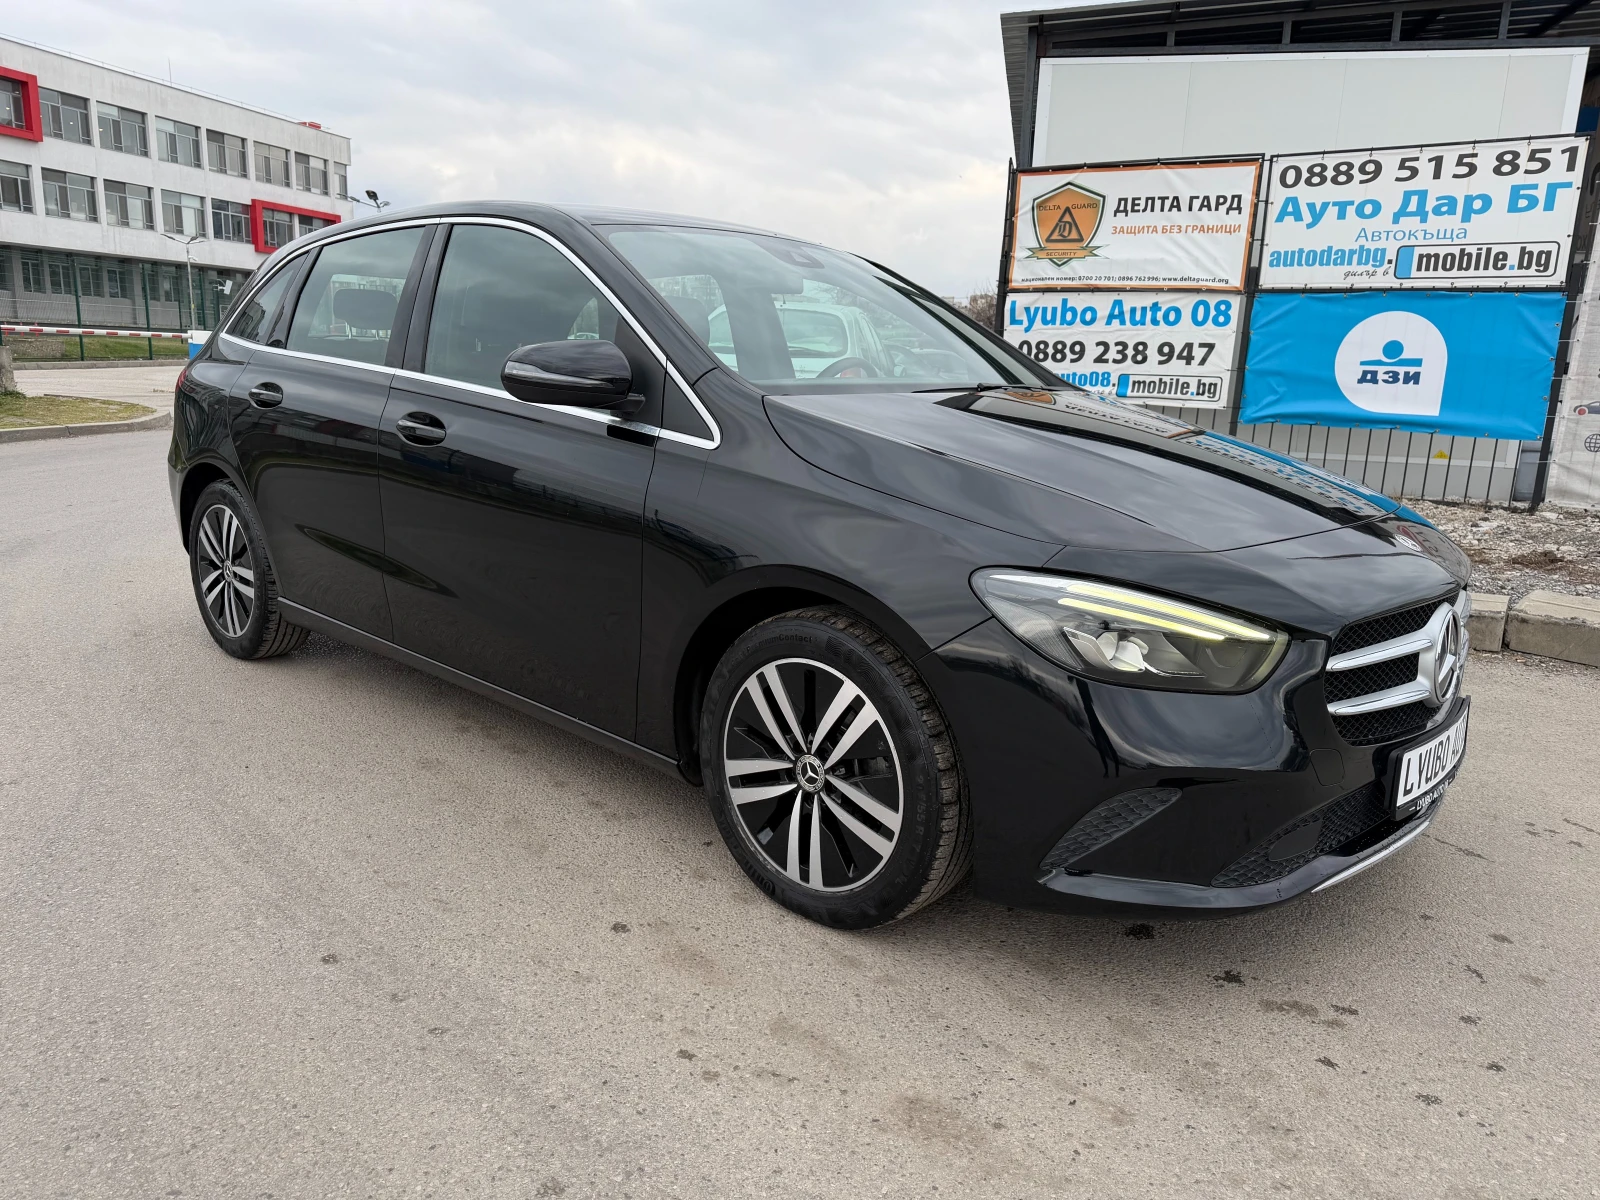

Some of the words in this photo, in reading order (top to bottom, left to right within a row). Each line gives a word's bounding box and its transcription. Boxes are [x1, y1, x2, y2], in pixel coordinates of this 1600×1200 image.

[1278, 159, 1383, 189] 0889
[1394, 152, 1479, 183] 515
[1491, 145, 1580, 177] 851
[1038, 204, 1061, 212] DELTA
[1071, 202, 1098, 210] GUARD
[1113, 195, 1182, 217] ДЕЛТА
[1188, 193, 1243, 216] ГАРД
[1274, 196, 1382, 230] Ауто
[1391, 188, 1493, 225] Дар
[1506, 181, 1574, 214] БГ
[1111, 224, 1158, 236] ЗАЩИТА
[1161, 224, 1182, 235] БЕЗ
[1185, 223, 1242, 236] ГРАНИЦИ
[1354, 226, 1468, 243] Автокъща
[1415, 245, 1552, 273] mobile.bg
[1162, 275, 1229, 284] www.deltaguard.org
[1009, 298, 1098, 333] Lyubo
[1105, 299, 1182, 327] Auto
[1190, 299, 1232, 328] 08
[1017, 339, 1086, 364] 0889
[1092, 340, 1149, 365] 238
[1156, 341, 1216, 367] 947
[1130, 377, 1218, 399] mobile.bg
[1356, 369, 1421, 386] ДЗИ
[1403, 734, 1450, 798] LYUBO
